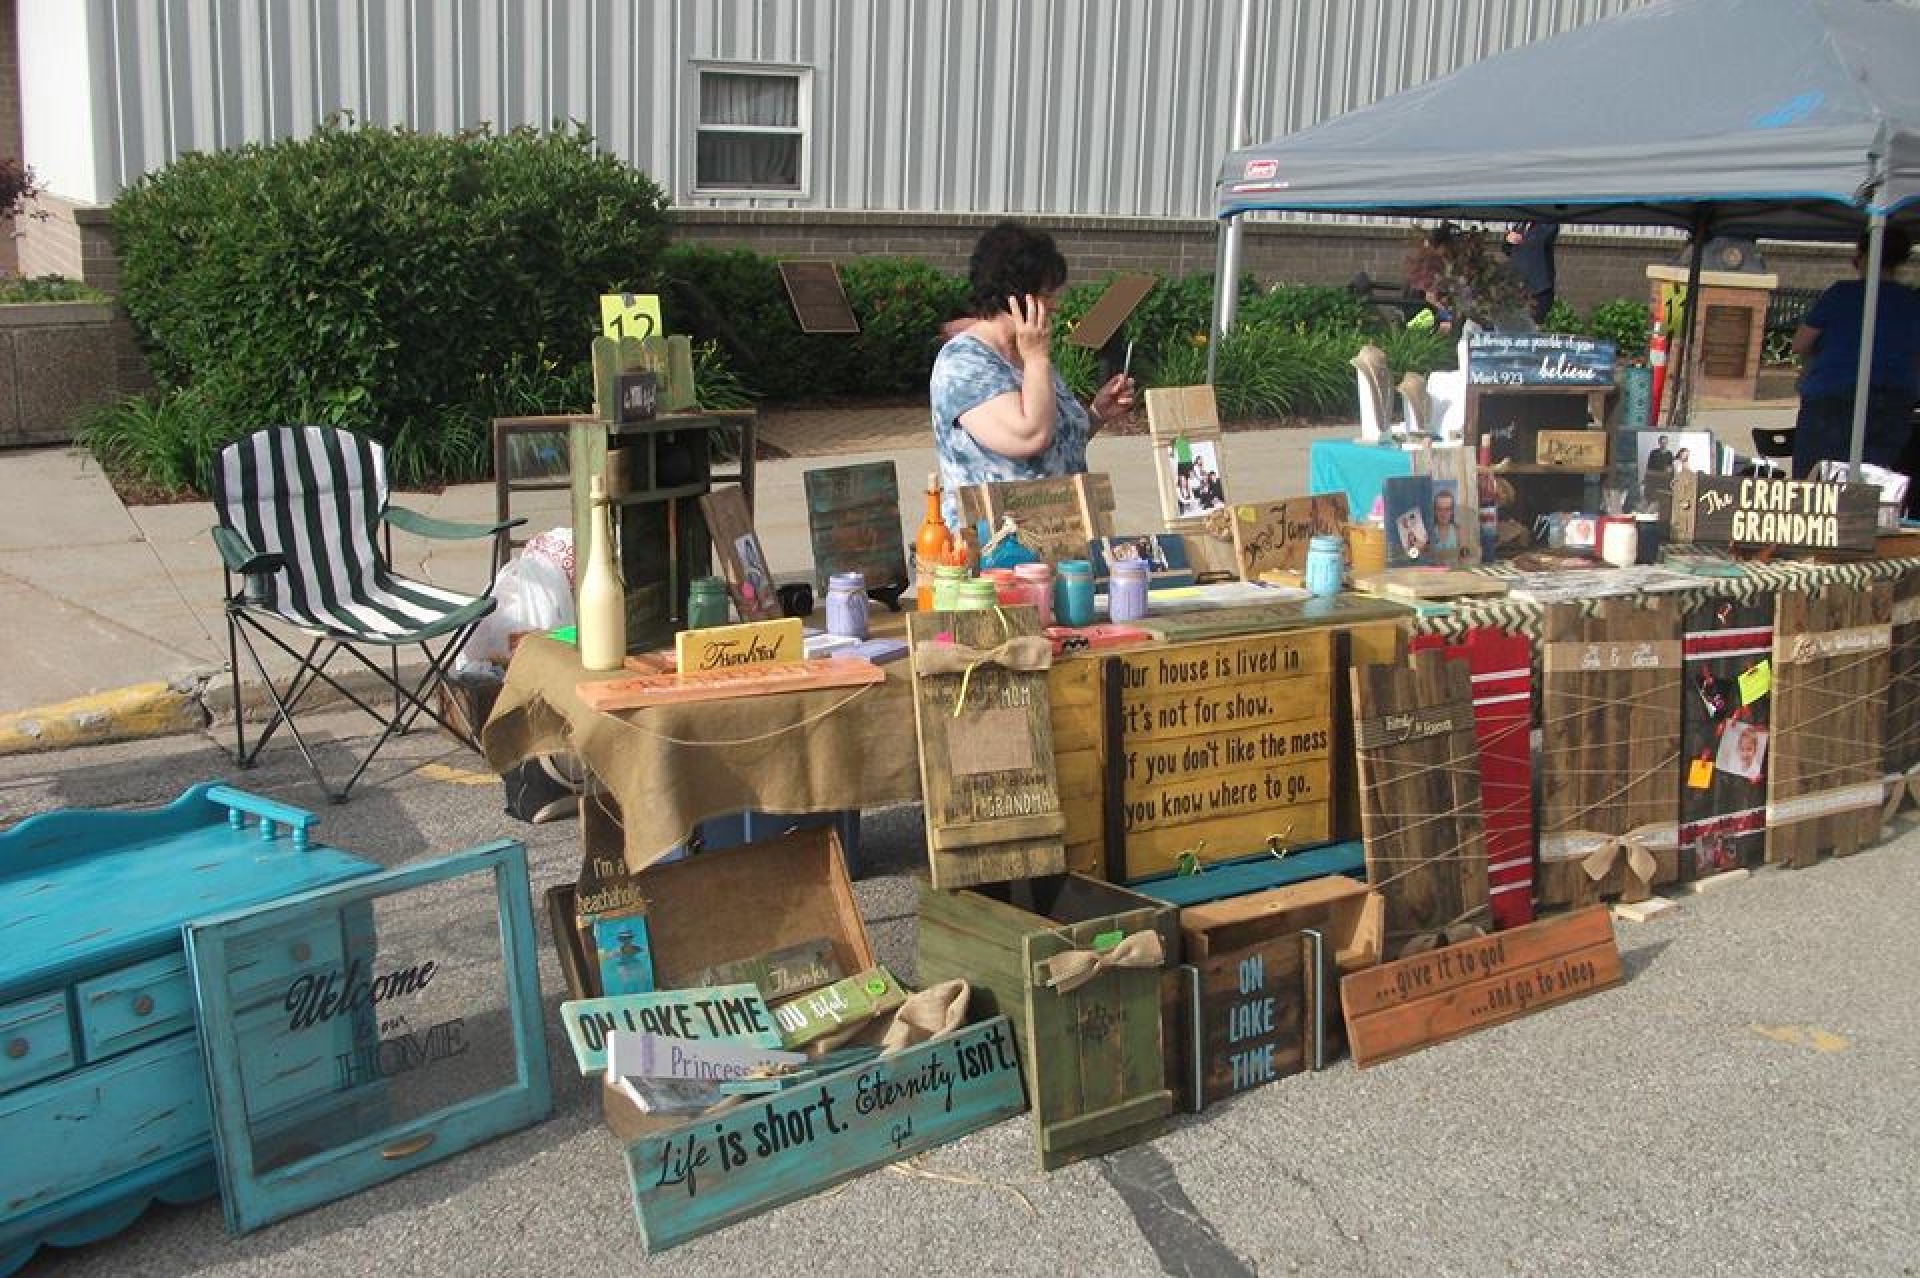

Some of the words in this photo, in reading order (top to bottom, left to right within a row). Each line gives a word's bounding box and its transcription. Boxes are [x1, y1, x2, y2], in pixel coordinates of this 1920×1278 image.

[609, 313, 655, 341] 12
[1700, 489, 1733, 515] The
[1731, 511, 1840, 548] GRANDMA
[1122, 661, 1149, 688] Our
[1159, 657, 1209, 685] house
[1215, 651, 1231, 678] is
[1237, 646, 1278, 676] lived
[1283, 645, 1300, 671] in
[1122, 703, 1153, 734] it's
[1159, 699, 1188, 729] not
[1194, 696, 1220, 727] for
[1226, 693, 1275, 720] show.
[1145, 752, 1177, 785] you
[1183, 740, 1219, 773] don't
[1224, 736, 1255, 765] like
[1260, 731, 1287, 760] the
[1291, 729, 1328, 755] mess
[1123, 800, 1155, 831] you
[1161, 791, 1203, 818] know
[1209, 780, 1257, 810] where
[1264, 773, 1282, 800] to
[1287, 775, 1311, 803] go.
[1238, 953, 1264, 996] ON
[1437, 950, 1453, 980] it
[1456, 946, 1476, 976] to
[285, 958, 439, 1032] Welcome
[1515, 978, 1534, 1010] go
[1536, 966, 1553, 994] to
[578, 1011, 618, 1052] ON
[694, 997, 769, 1038] TIME
[1228, 997, 1276, 1043] LAKE
[334, 1017, 470, 1090] HOME
[1229, 1043, 1276, 1091] TIME
[655, 1133, 711, 1197] Life
[714, 1123, 748, 1172] is
[753, 1085, 848, 1157] short.
[855, 1051, 956, 1116] Eternity
[954, 1023, 1017, 1082] isn't.
